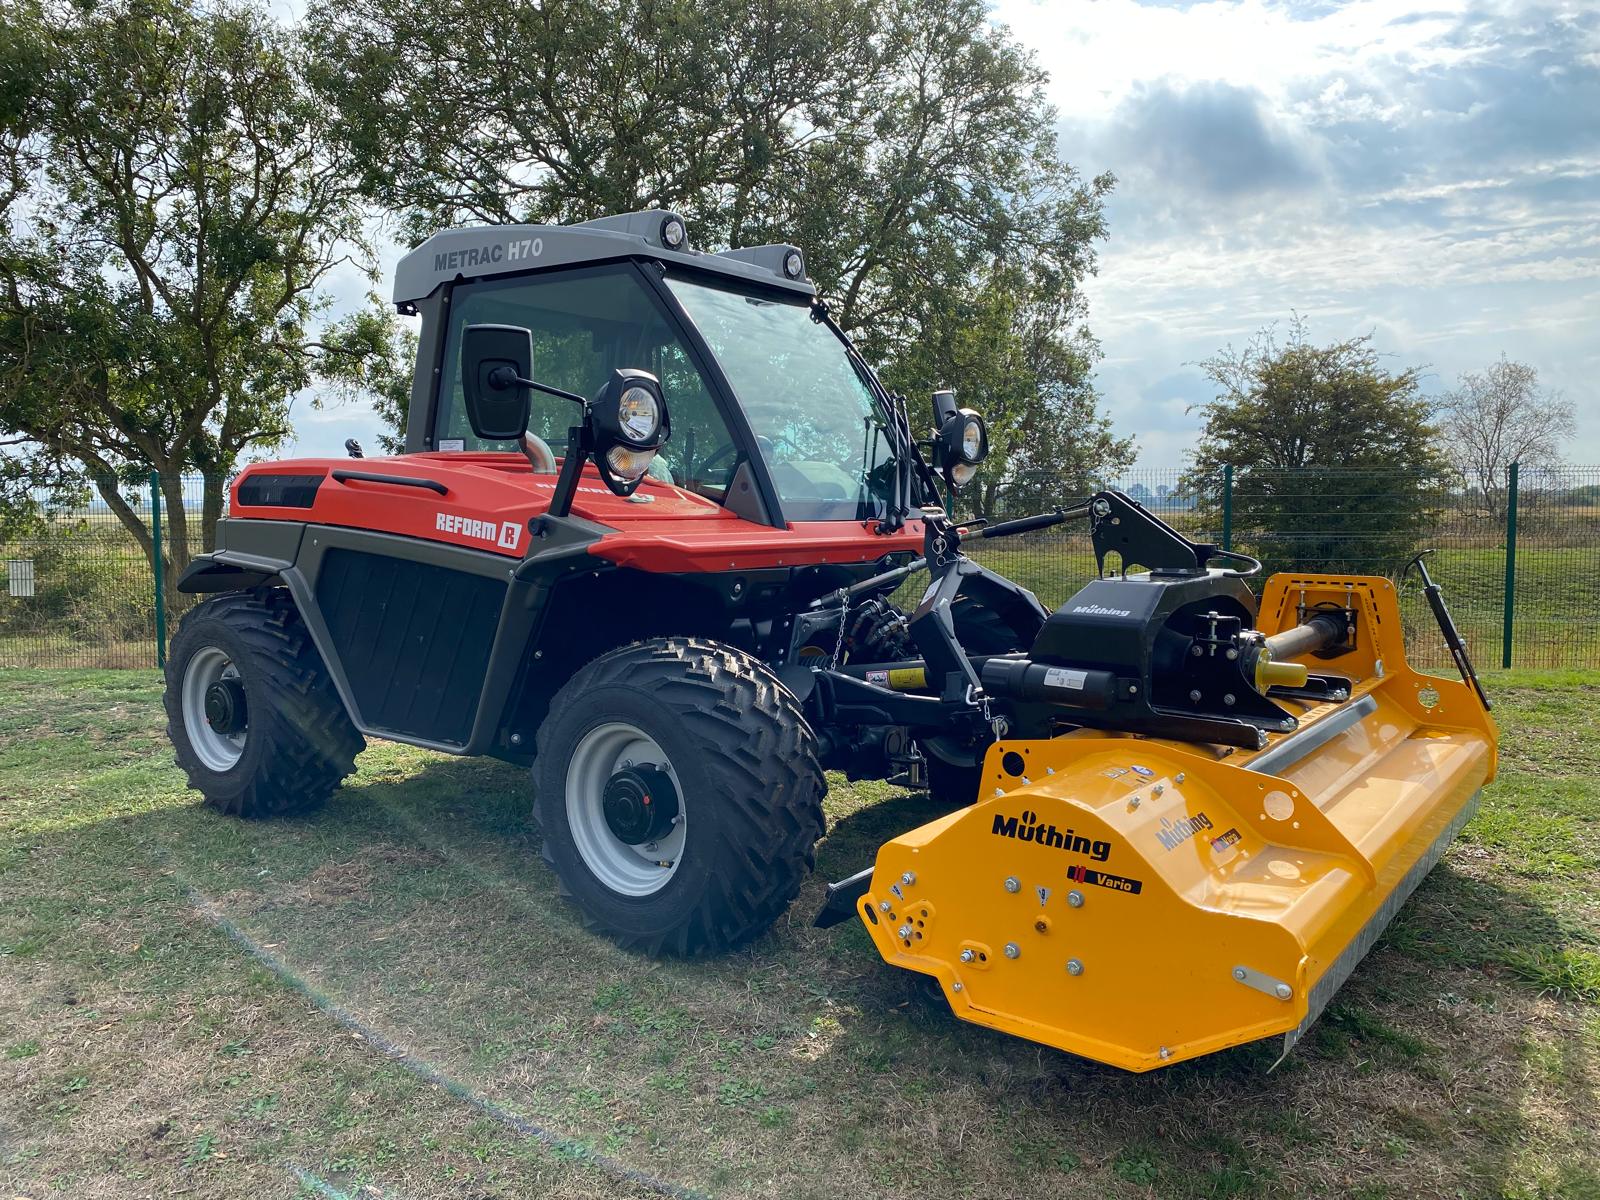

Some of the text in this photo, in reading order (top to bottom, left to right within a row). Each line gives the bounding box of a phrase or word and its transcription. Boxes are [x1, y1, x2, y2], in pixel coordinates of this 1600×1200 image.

[434, 238, 544, 271] METRAC H70
[436, 512, 497, 541] REFORM
[1072, 604, 1131, 617] Müthing
[991, 810, 1112, 862] Müthing
[1155, 811, 1213, 852] Müthing
[1097, 873, 1133, 892] Vario
